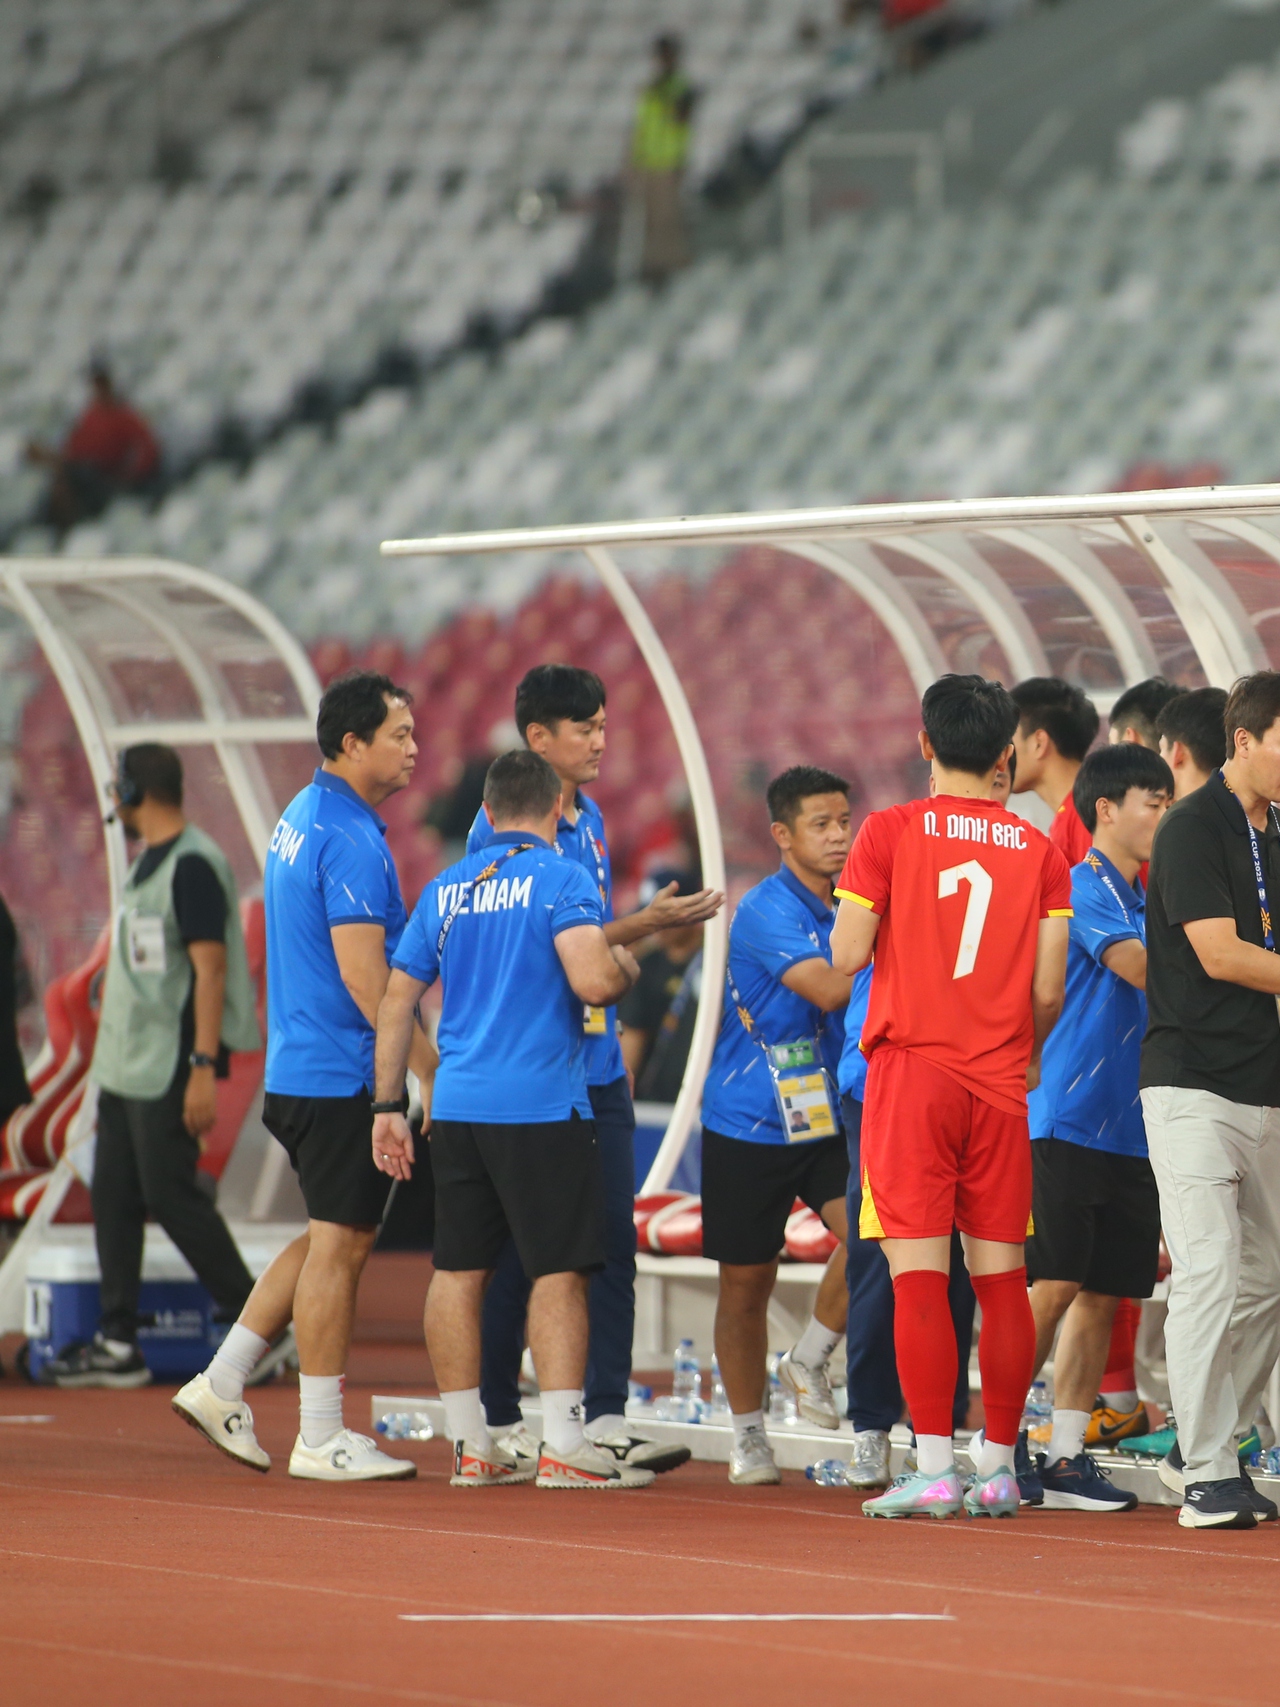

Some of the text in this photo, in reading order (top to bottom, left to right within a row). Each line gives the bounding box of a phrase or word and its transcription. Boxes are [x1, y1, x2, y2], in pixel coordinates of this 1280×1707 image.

[924, 810, 1027, 850] N. DINH BAC
[1251, 841, 1259, 859] CUP
[1254, 861, 1263, 882] 2025
[437, 875, 533, 917] VIETNAM
[938, 859, 993, 980] 7
